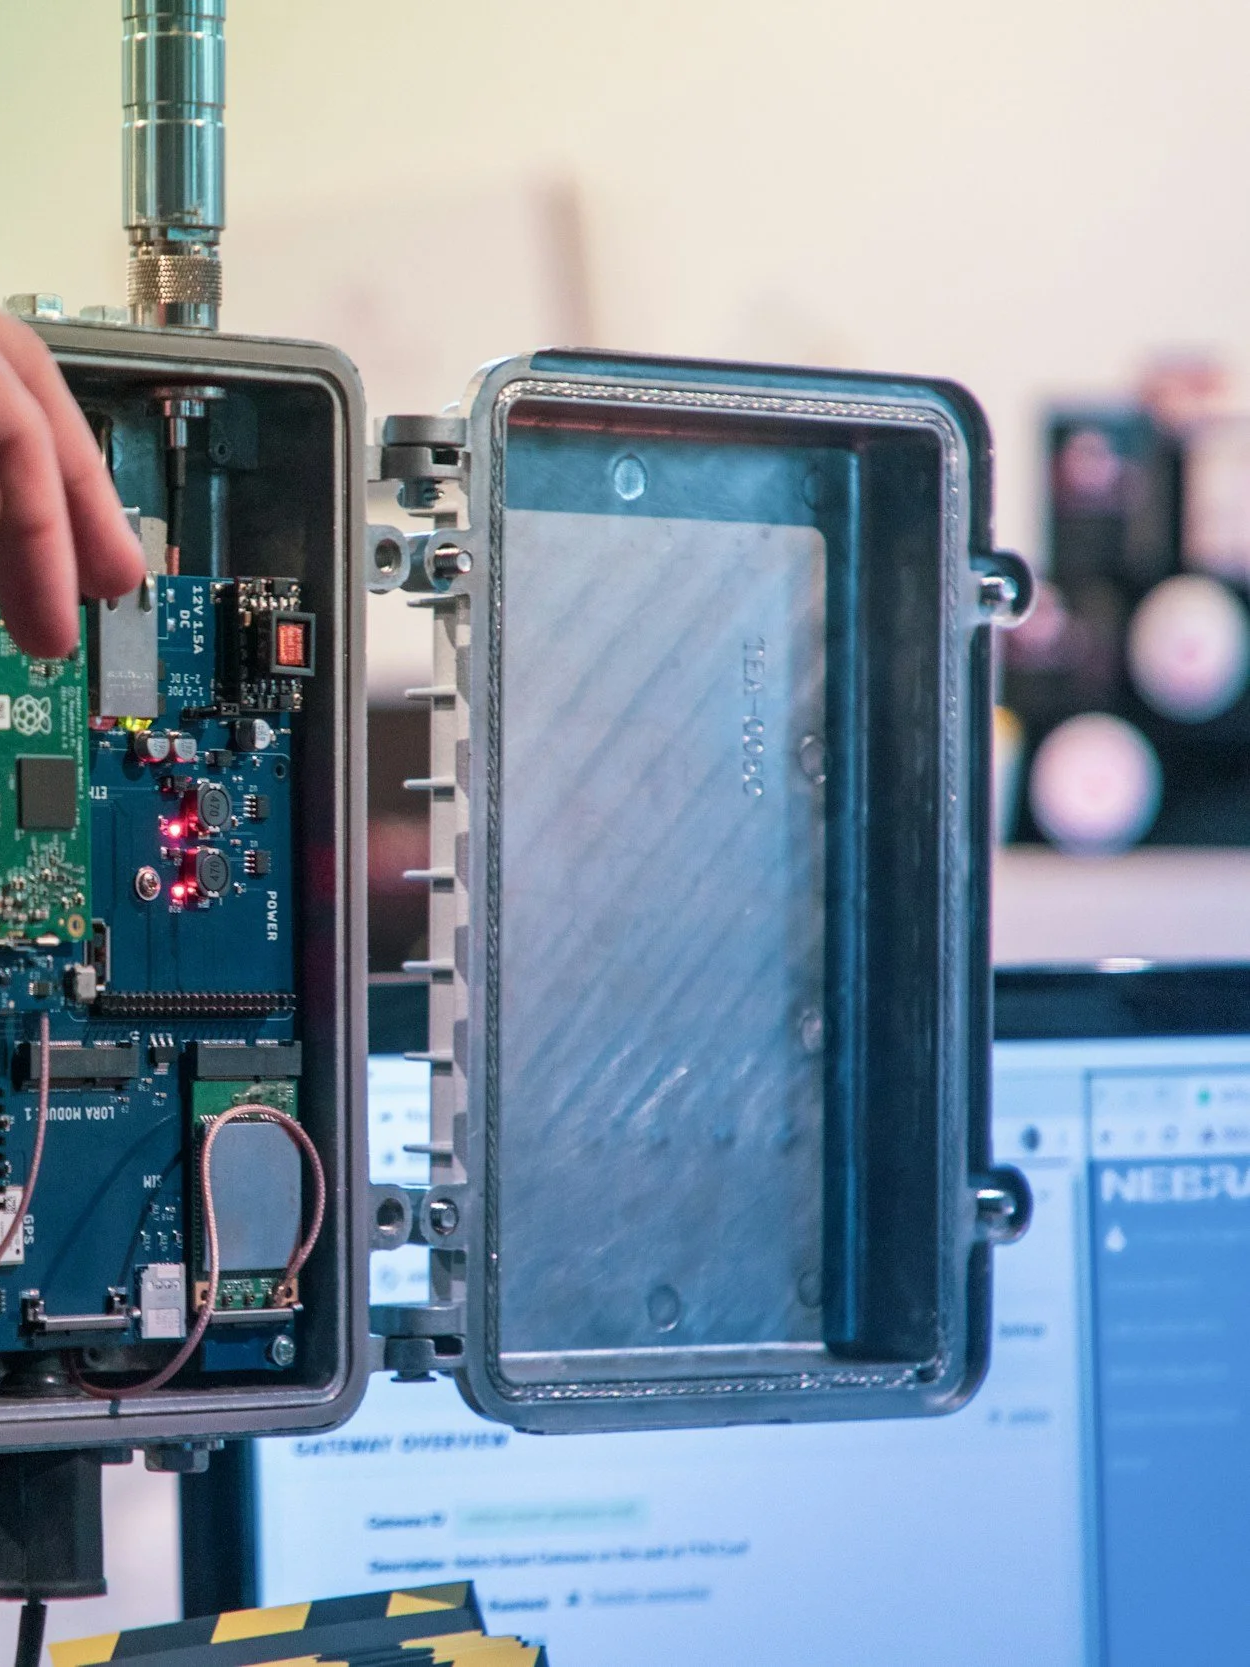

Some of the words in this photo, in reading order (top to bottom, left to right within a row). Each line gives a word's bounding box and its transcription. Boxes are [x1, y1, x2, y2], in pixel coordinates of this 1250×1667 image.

[192, 585, 205, 616] 12V
[179, 609, 191, 630] DC
[192, 620, 205, 655] 1.5A
[170, 673, 181, 684] DC
[183, 673, 202, 684] 2-3
[167, 685, 184, 697] POE
[185, 686, 204, 697] 1-2
[209, 795, 220, 817] 470
[209, 861, 220, 882] 470
[266, 890, 278, 941] POWER
[23, 1107, 32, 1121] 1
[35, 1106, 81, 1121] MODU
[85, 1105, 115, 1121] LORA
[143, 1174, 163, 1189] SIM
[23, 1213, 35, 1245] GPS
